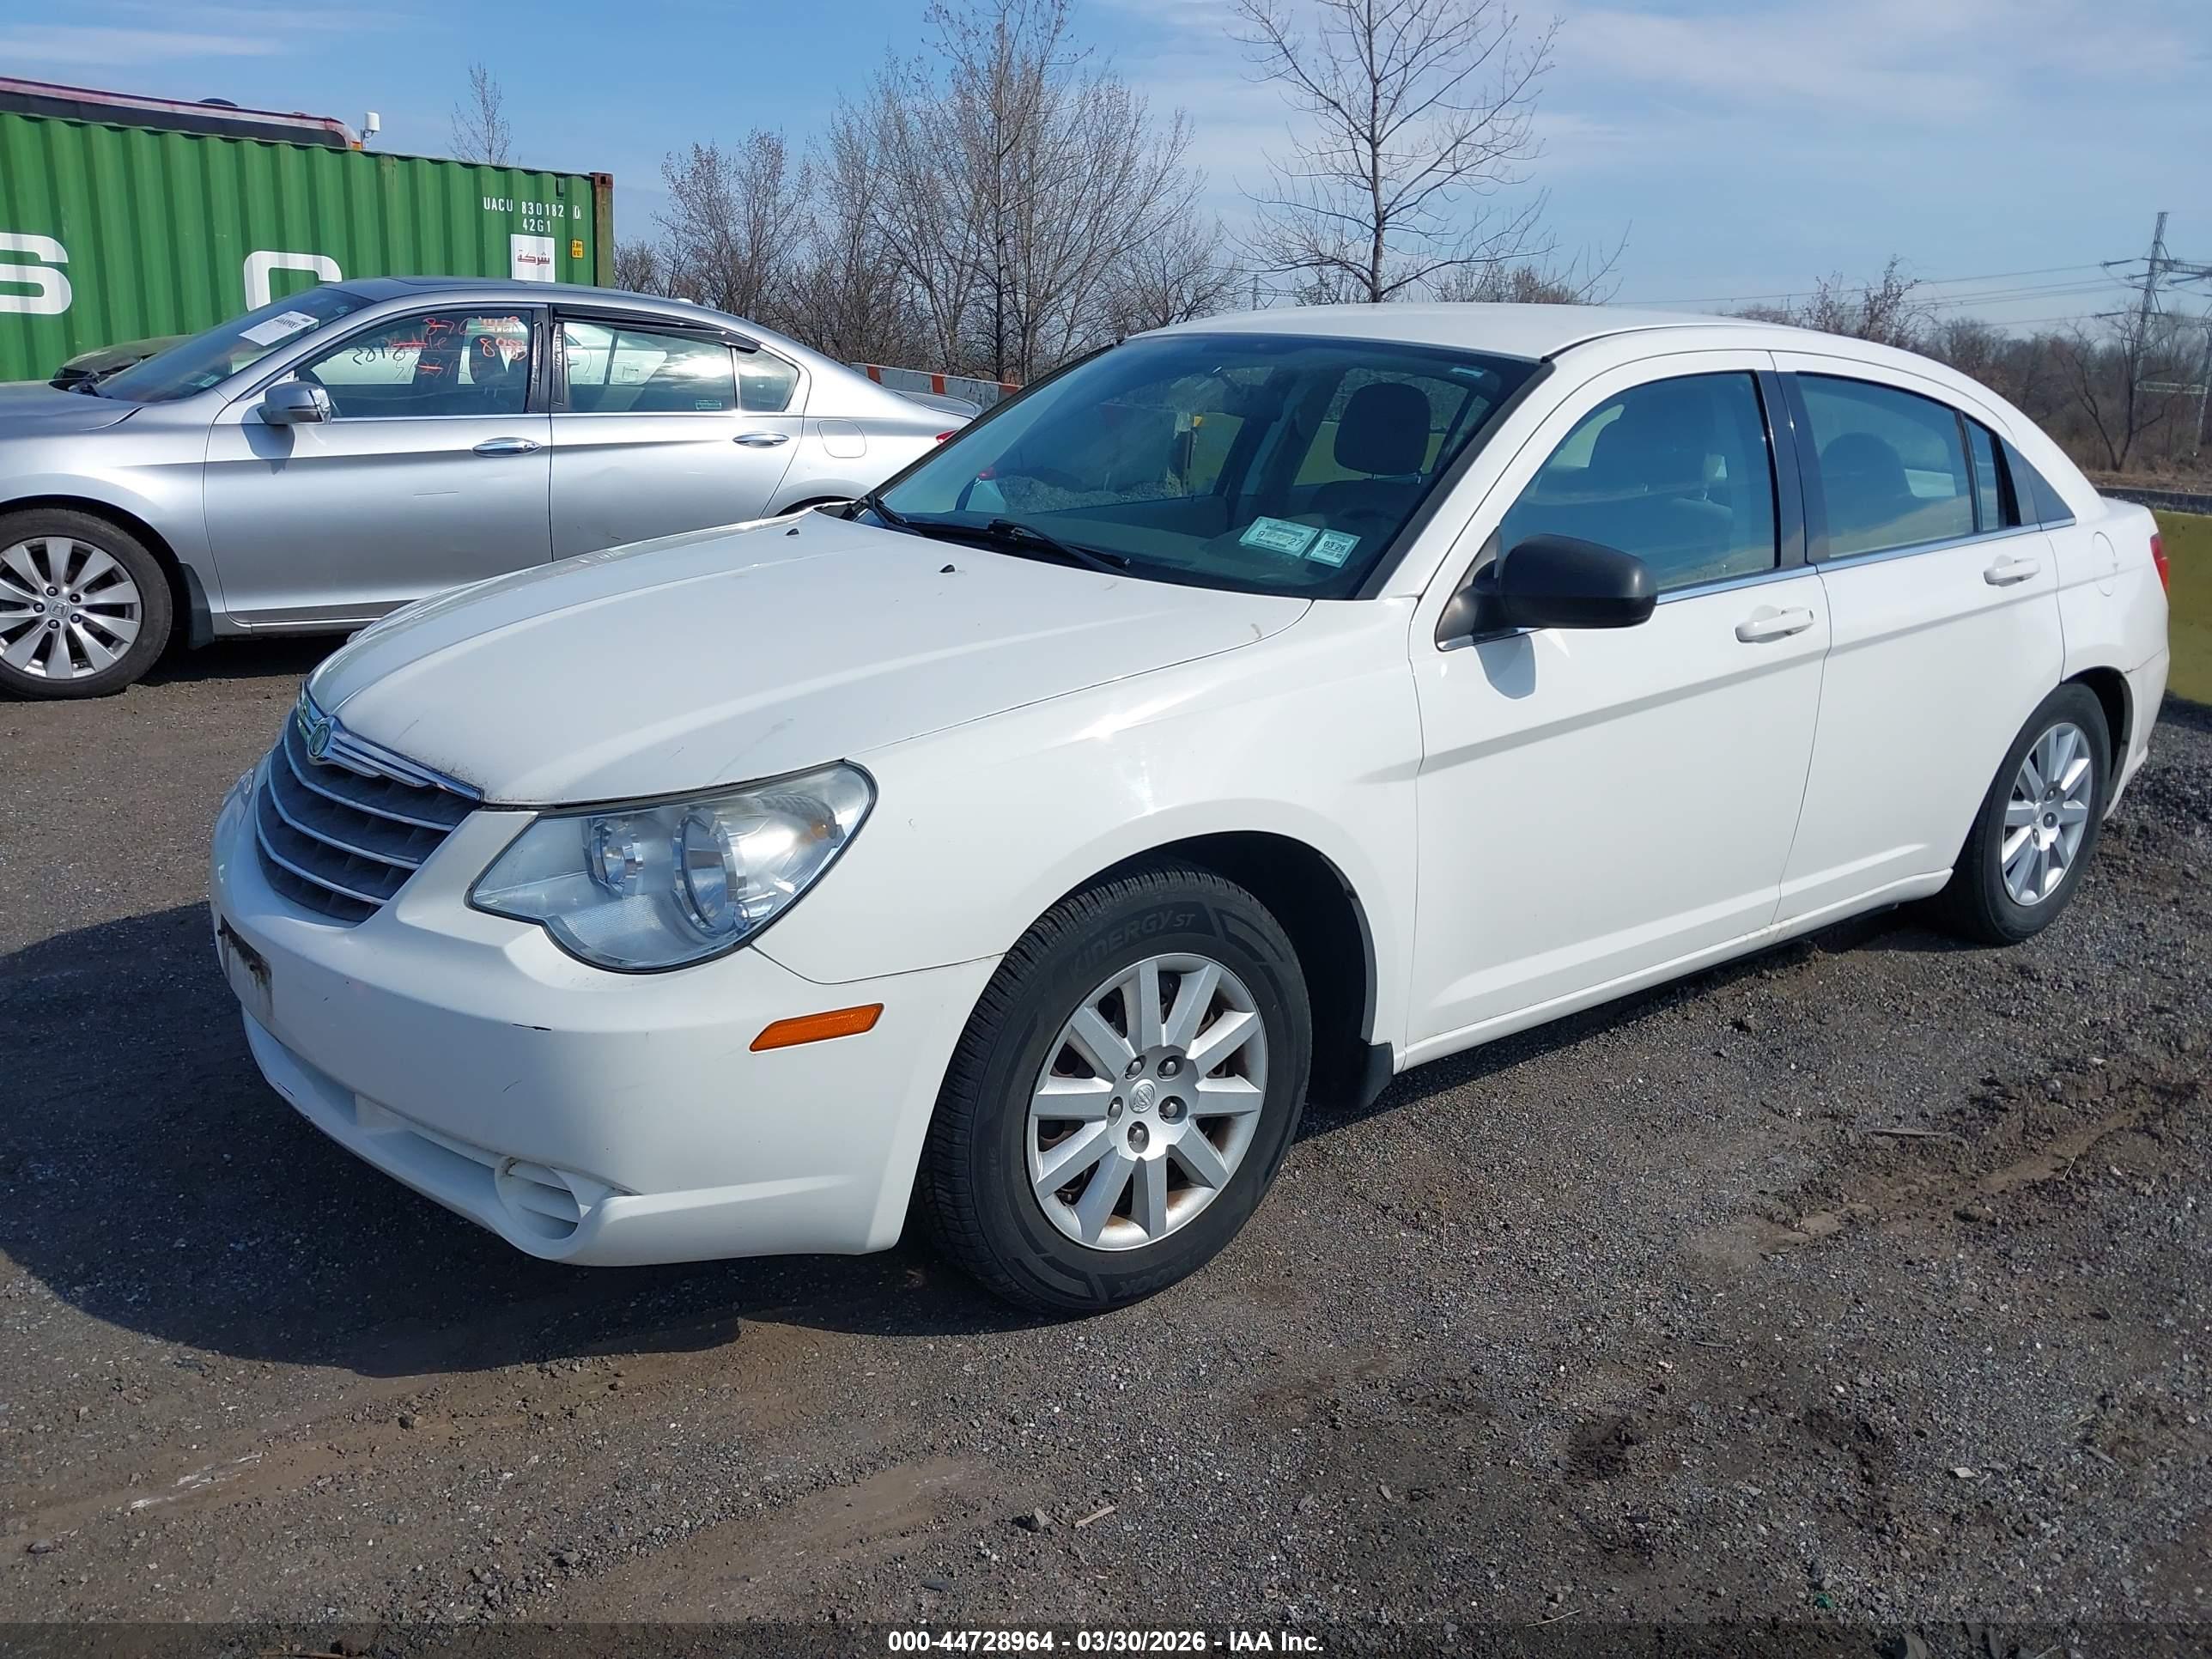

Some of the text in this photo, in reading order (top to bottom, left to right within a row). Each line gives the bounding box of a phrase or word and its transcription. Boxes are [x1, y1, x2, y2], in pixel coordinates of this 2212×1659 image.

[483, 197, 514, 212] UACU
[521, 201, 564, 217] 830182
[522, 218, 550, 233] 42G1
[1288, 538, 1304, 547] 27
